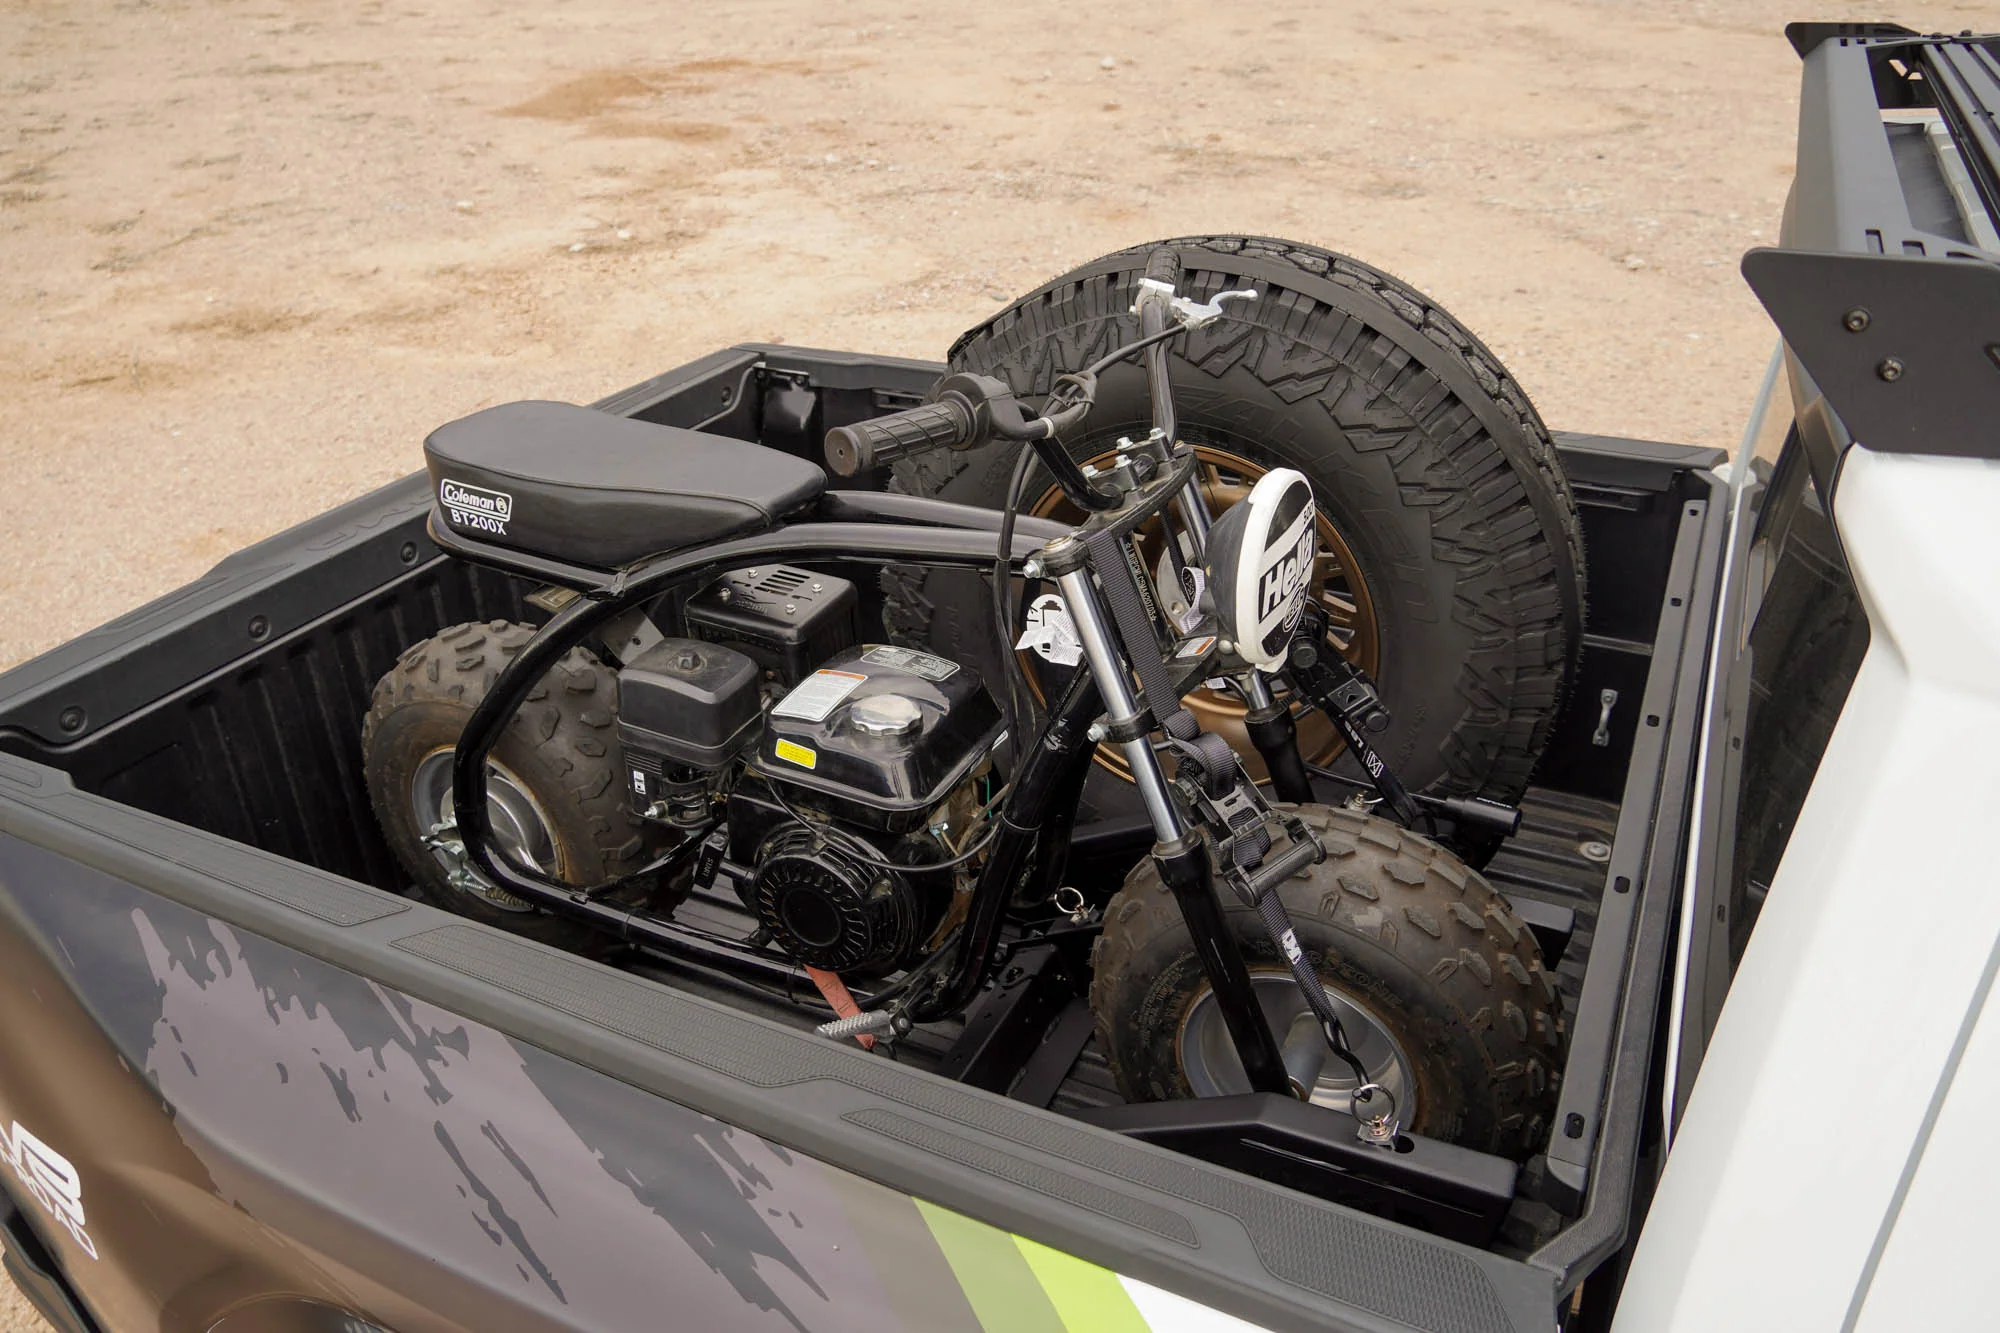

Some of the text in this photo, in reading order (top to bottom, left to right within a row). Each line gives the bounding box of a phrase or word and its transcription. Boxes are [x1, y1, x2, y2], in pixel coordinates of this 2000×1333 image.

[444, 484, 495, 511] Coleman
[450, 508, 507, 535] BT200X
[1262, 528, 1314, 617] Hella
